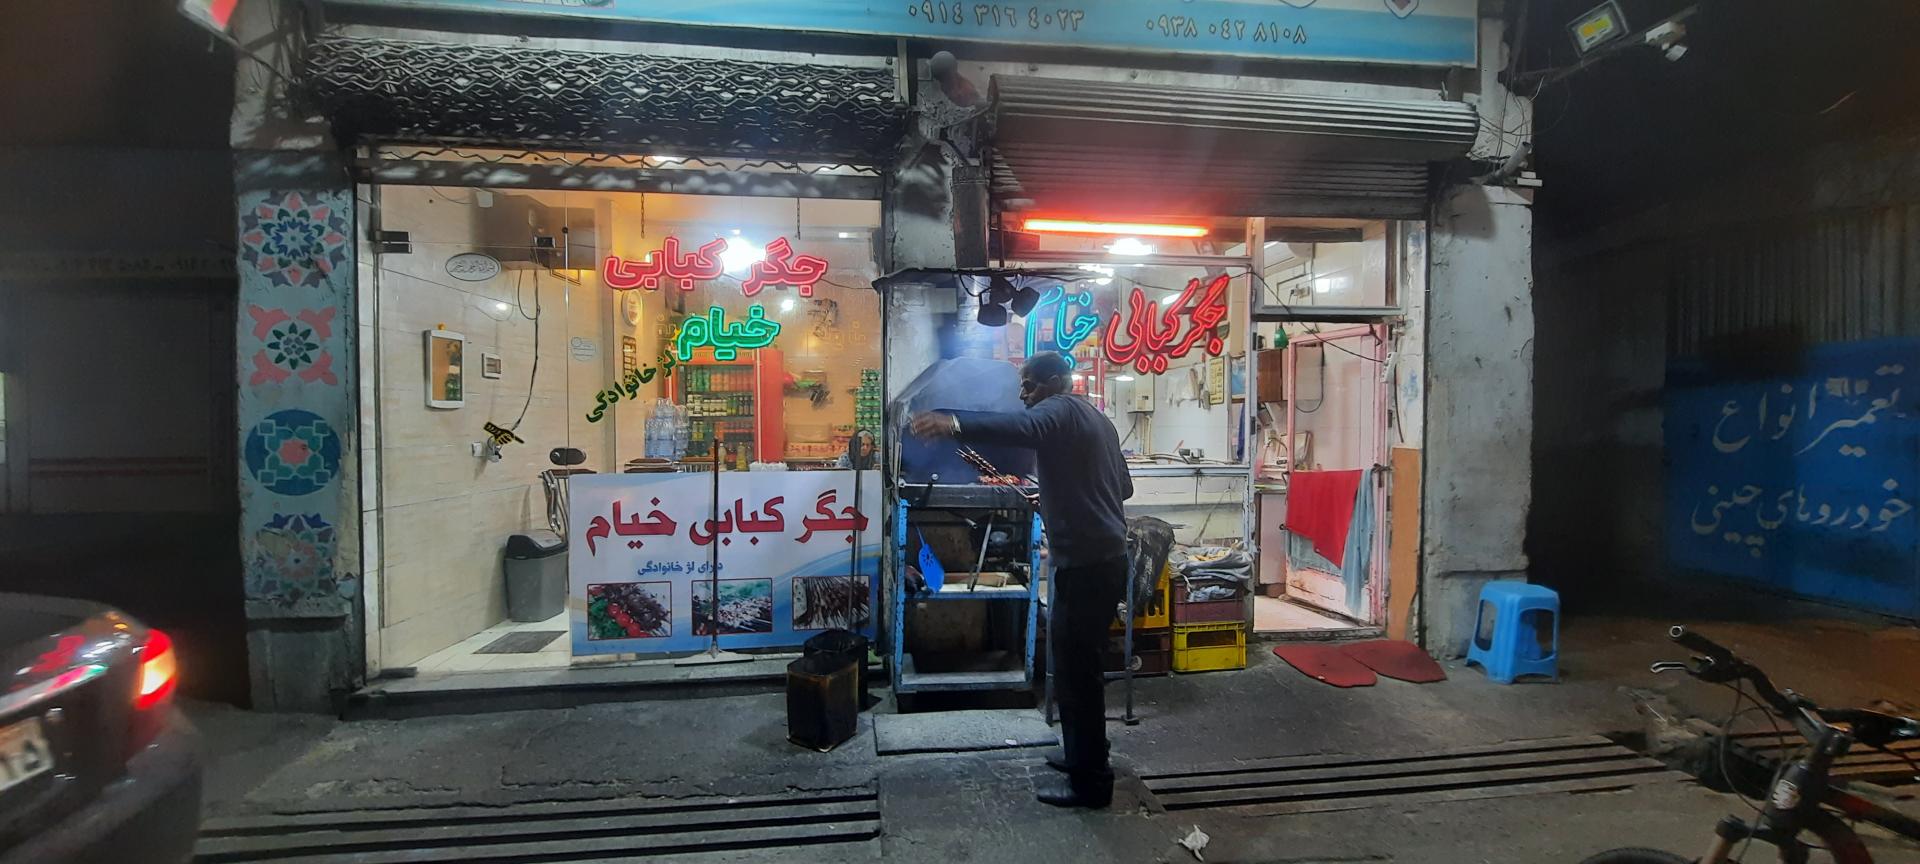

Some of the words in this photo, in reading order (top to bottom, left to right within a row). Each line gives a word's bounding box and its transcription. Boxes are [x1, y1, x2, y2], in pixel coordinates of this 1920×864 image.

[603, 236, 728, 291] کبابی
[742, 236, 828, 297] جگر
[676, 305, 781, 362] خیام
[1103, 276, 1200, 376] کبابی
[1168, 274, 1232, 359] جگر
[584, 363, 657, 424] خانوادگی
[1712, 382, 1817, 454] انواع
[585, 496, 677, 557] خیام
[689, 496, 785, 546] کبابی
[794, 488, 869, 544] جگر
[1691, 484, 1764, 558] چینی
[637, 561, 683, 576] خانوادگی
